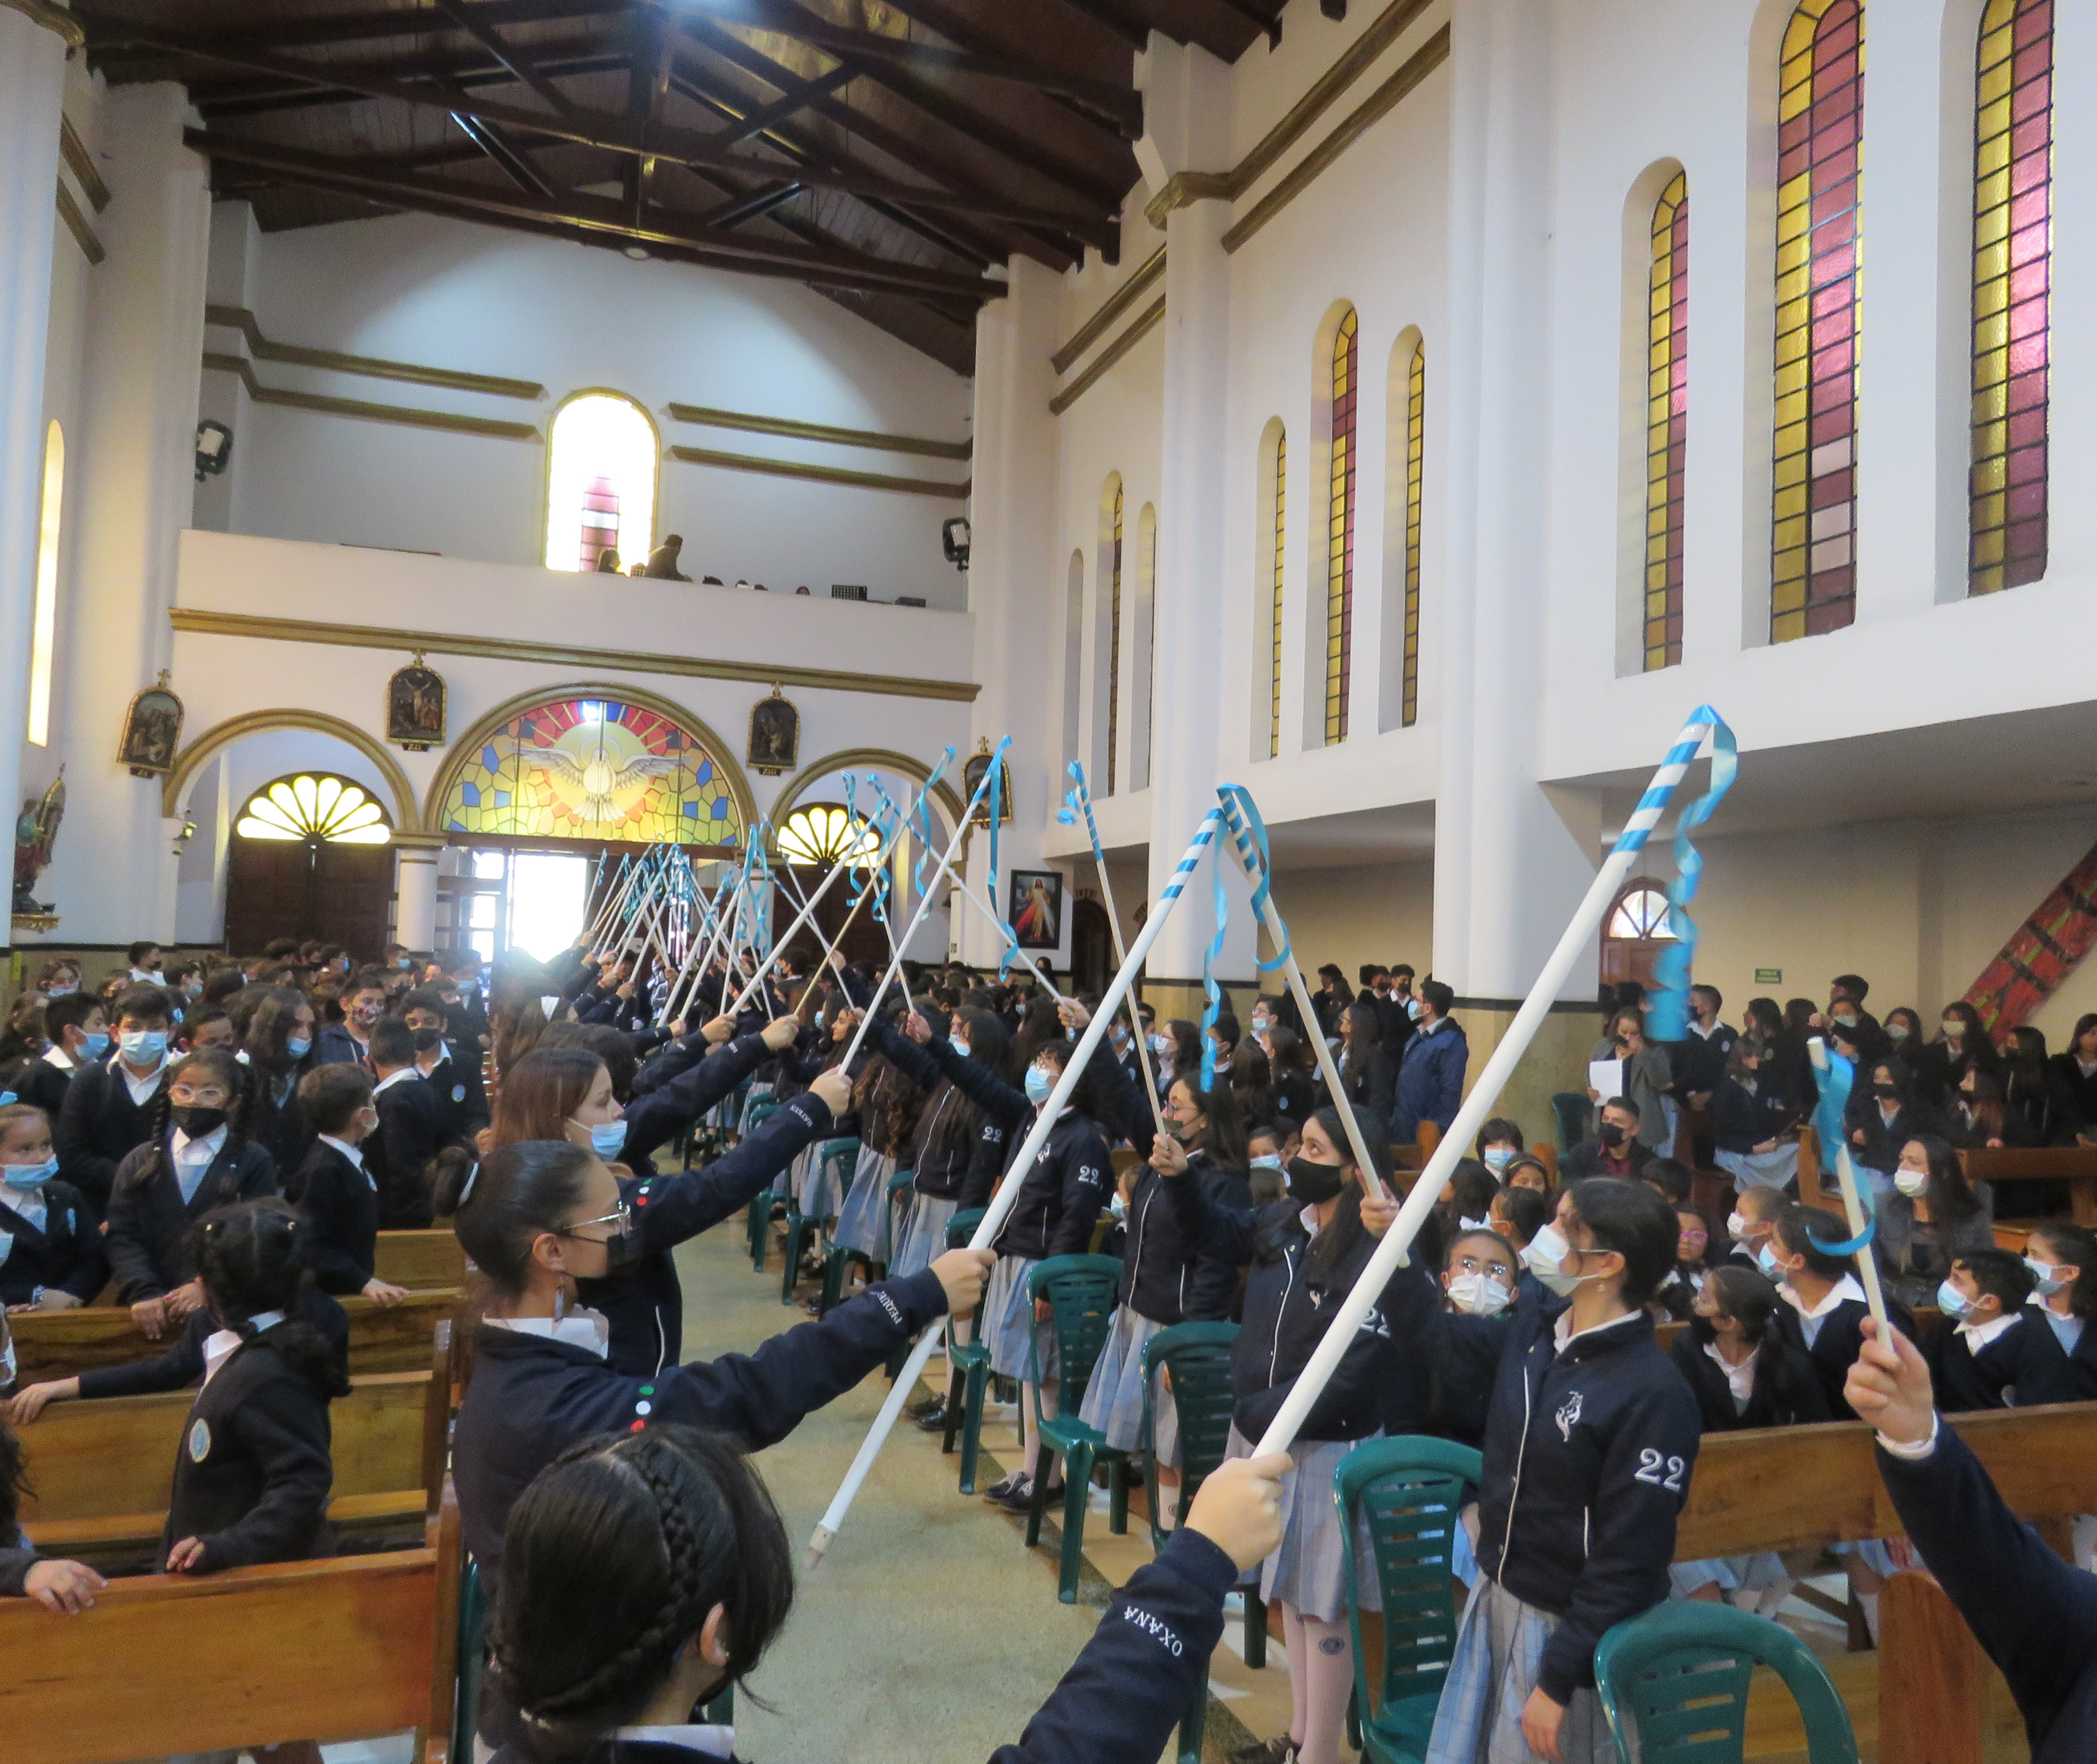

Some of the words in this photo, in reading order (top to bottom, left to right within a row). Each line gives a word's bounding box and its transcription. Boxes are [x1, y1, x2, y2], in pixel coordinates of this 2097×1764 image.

[982, 1126, 1002, 1143] 22
[1078, 1165, 1099, 1186] 22
[1634, 1447, 1685, 1493] 22
[1124, 1605, 1183, 1656] OXANA
